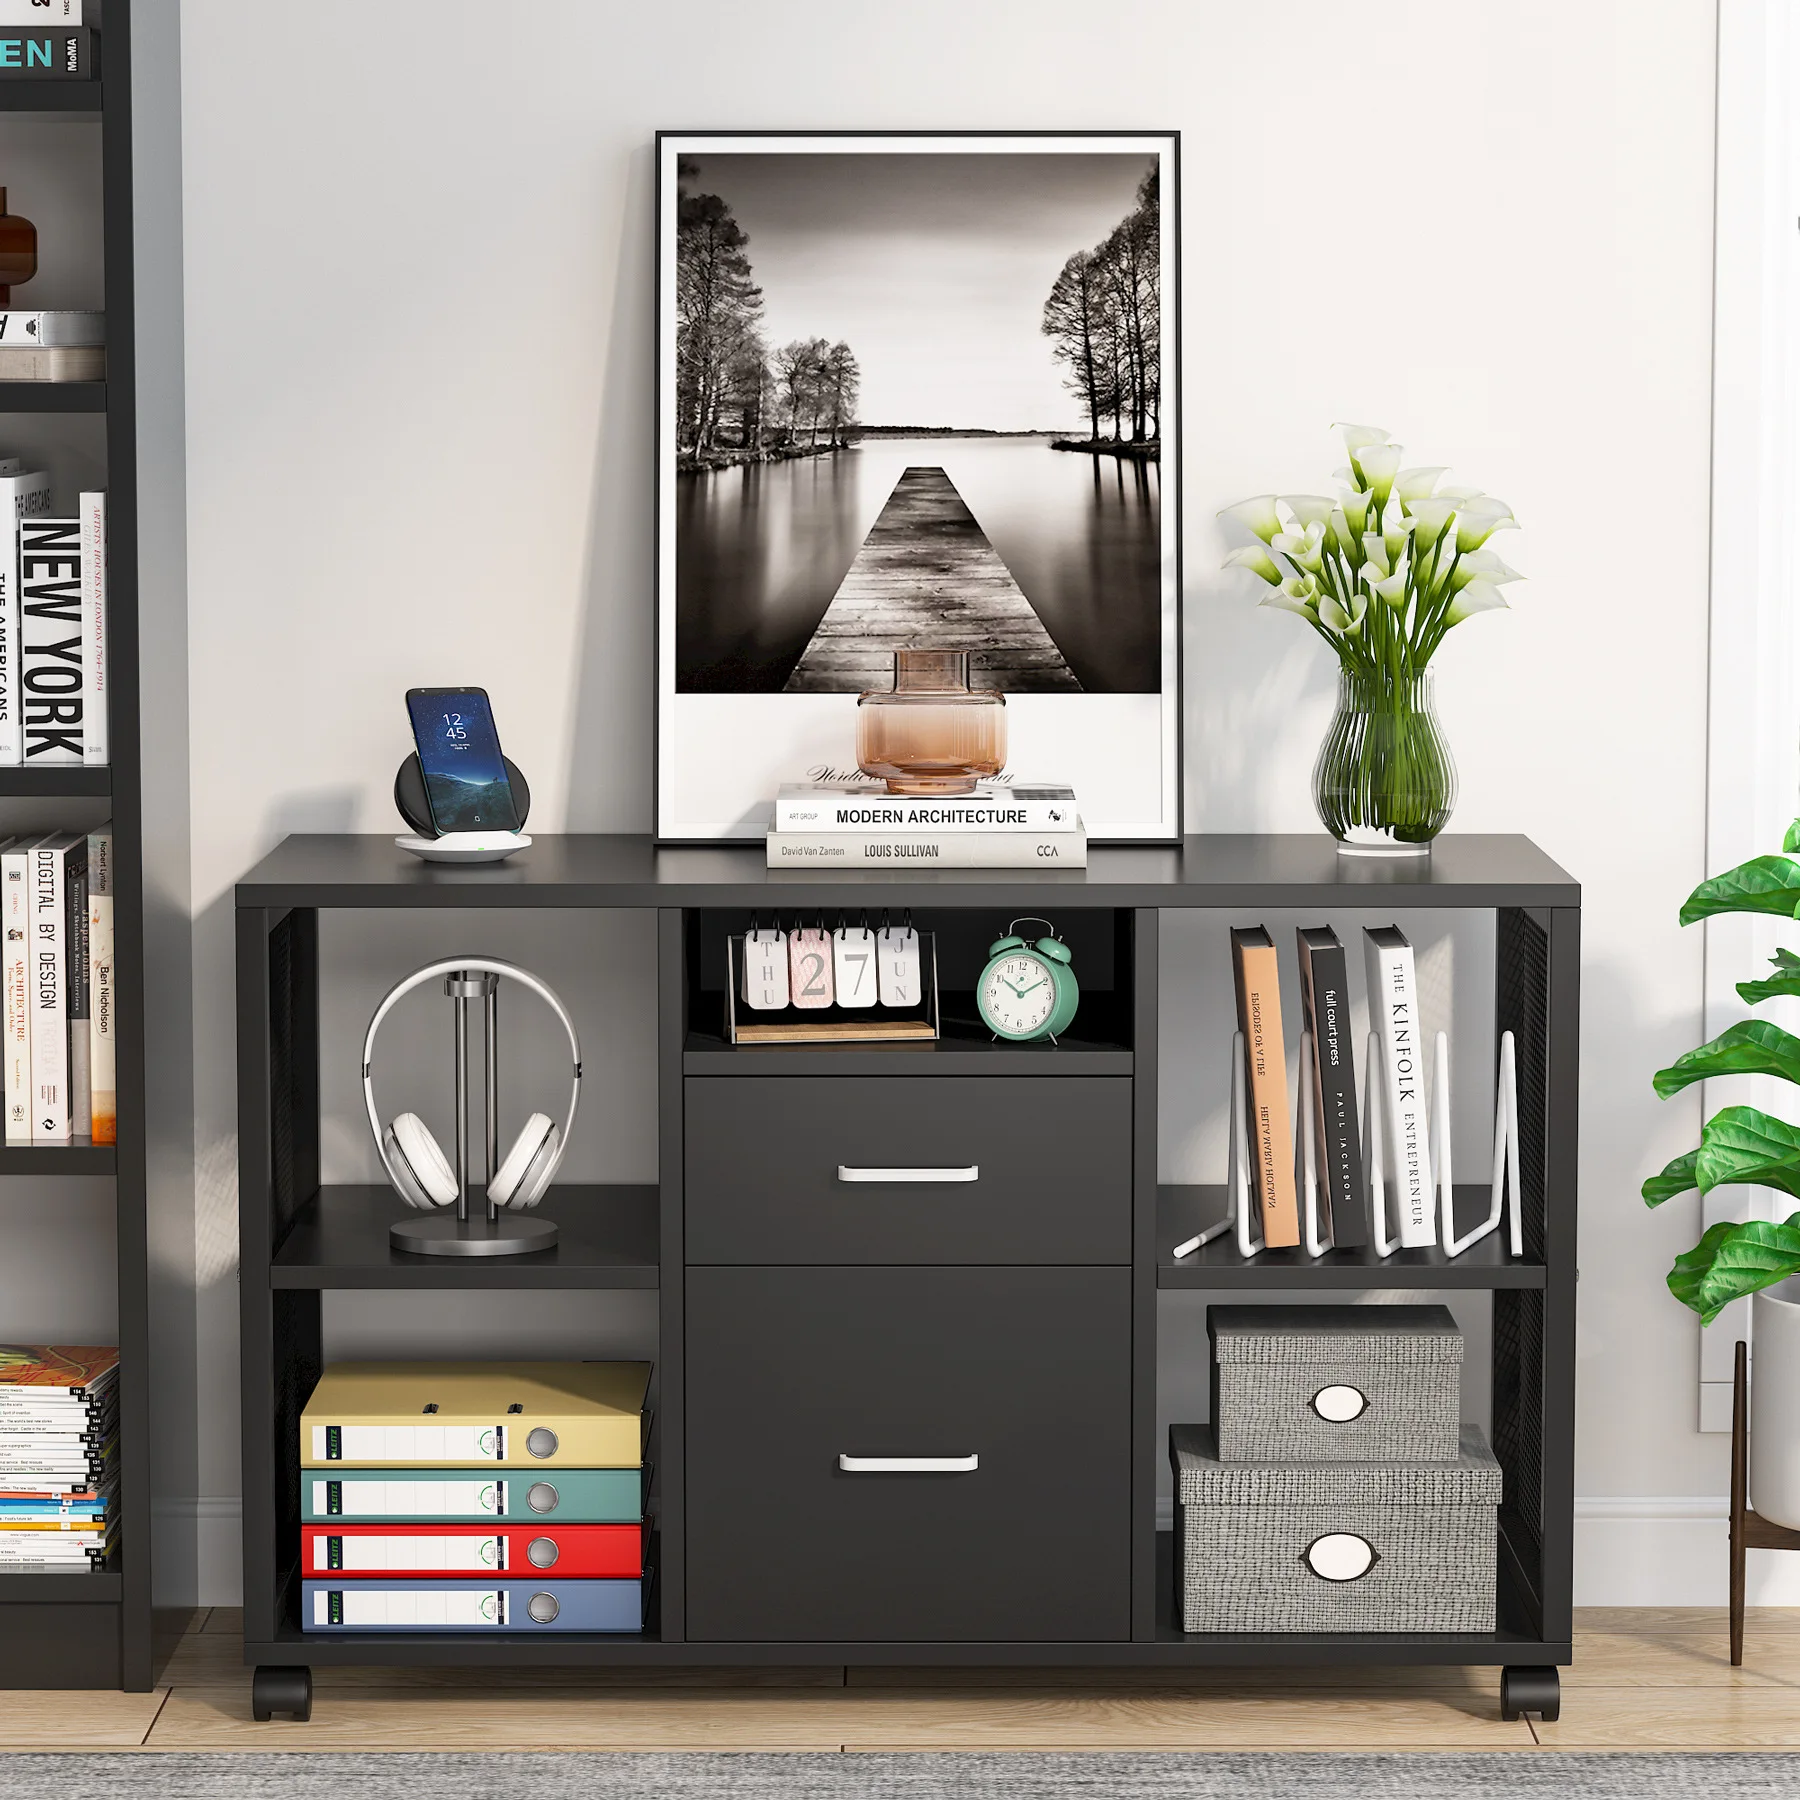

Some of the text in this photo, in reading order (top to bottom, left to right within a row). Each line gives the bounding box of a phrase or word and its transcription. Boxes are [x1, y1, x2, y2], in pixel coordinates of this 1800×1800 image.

[66, 38, 78, 72] MoMA
[94, 549, 102, 587] HOUSES
[95, 589, 102, 600] IN
[95, 602, 103, 642] LONDON
[22, 523, 84, 757] NEW YORK
[443, 713, 463, 725] 12
[446, 727, 467, 739] 45
[837, 810, 1027, 823] MODERN ARCHITECTURE
[781, 846, 845, 856] David Van Zanten
[864, 845, 939, 857] LOUIS SULLIVAN
[99, 841, 108, 892] Norbert Lynton
[38, 851, 55, 913] DIGITAL
[39, 924, 56, 942] BY
[80, 909, 90, 984] Jasper Johns
[1019, 962, 1027, 970] 12
[39, 953, 57, 1009] DESIGN
[15, 959, 26, 1042] ARCHITECTURE
[100, 967, 110, 1034] Ben Nicholson
[990, 989, 996, 997] 9
[1046, 992, 1051, 1000] 3
[994, 1004, 999, 1012] 8
[1032, 1015, 1037, 1024] 5
[1017, 1019, 1022, 1028] 6
[1325, 990, 1340, 1066] full court press
[1393, 964, 1423, 1226] THE KINFOLK ENTREPRENEUR
[1336, 1092, 1352, 1200] PAUL JACKSON
[331, 1539, 339, 1562] LEITZ
